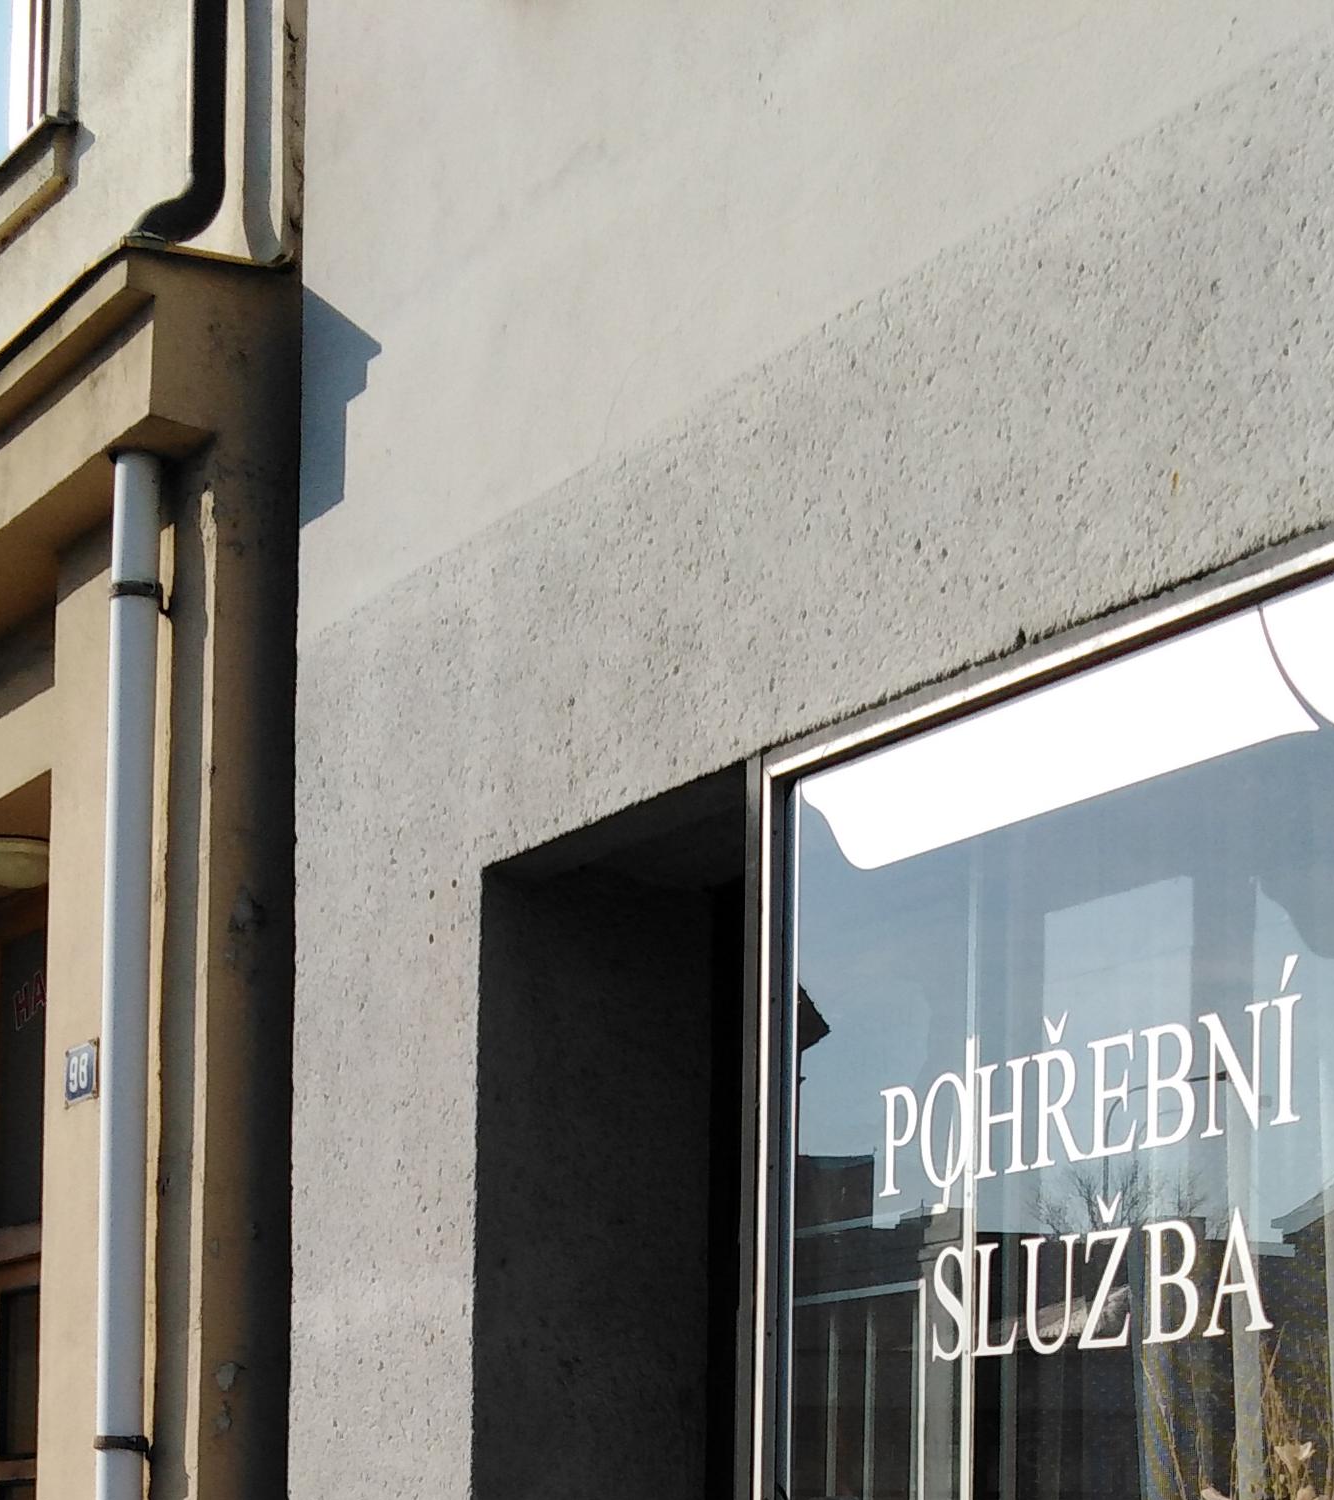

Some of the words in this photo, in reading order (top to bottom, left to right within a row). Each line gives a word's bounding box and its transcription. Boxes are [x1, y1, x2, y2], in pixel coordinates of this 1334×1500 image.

[69, 1052, 89, 1093] 98
[878, 953, 1303, 1198] POHŘEBNÍ
[931, 1191, 1274, 1364] SLUŽBA
